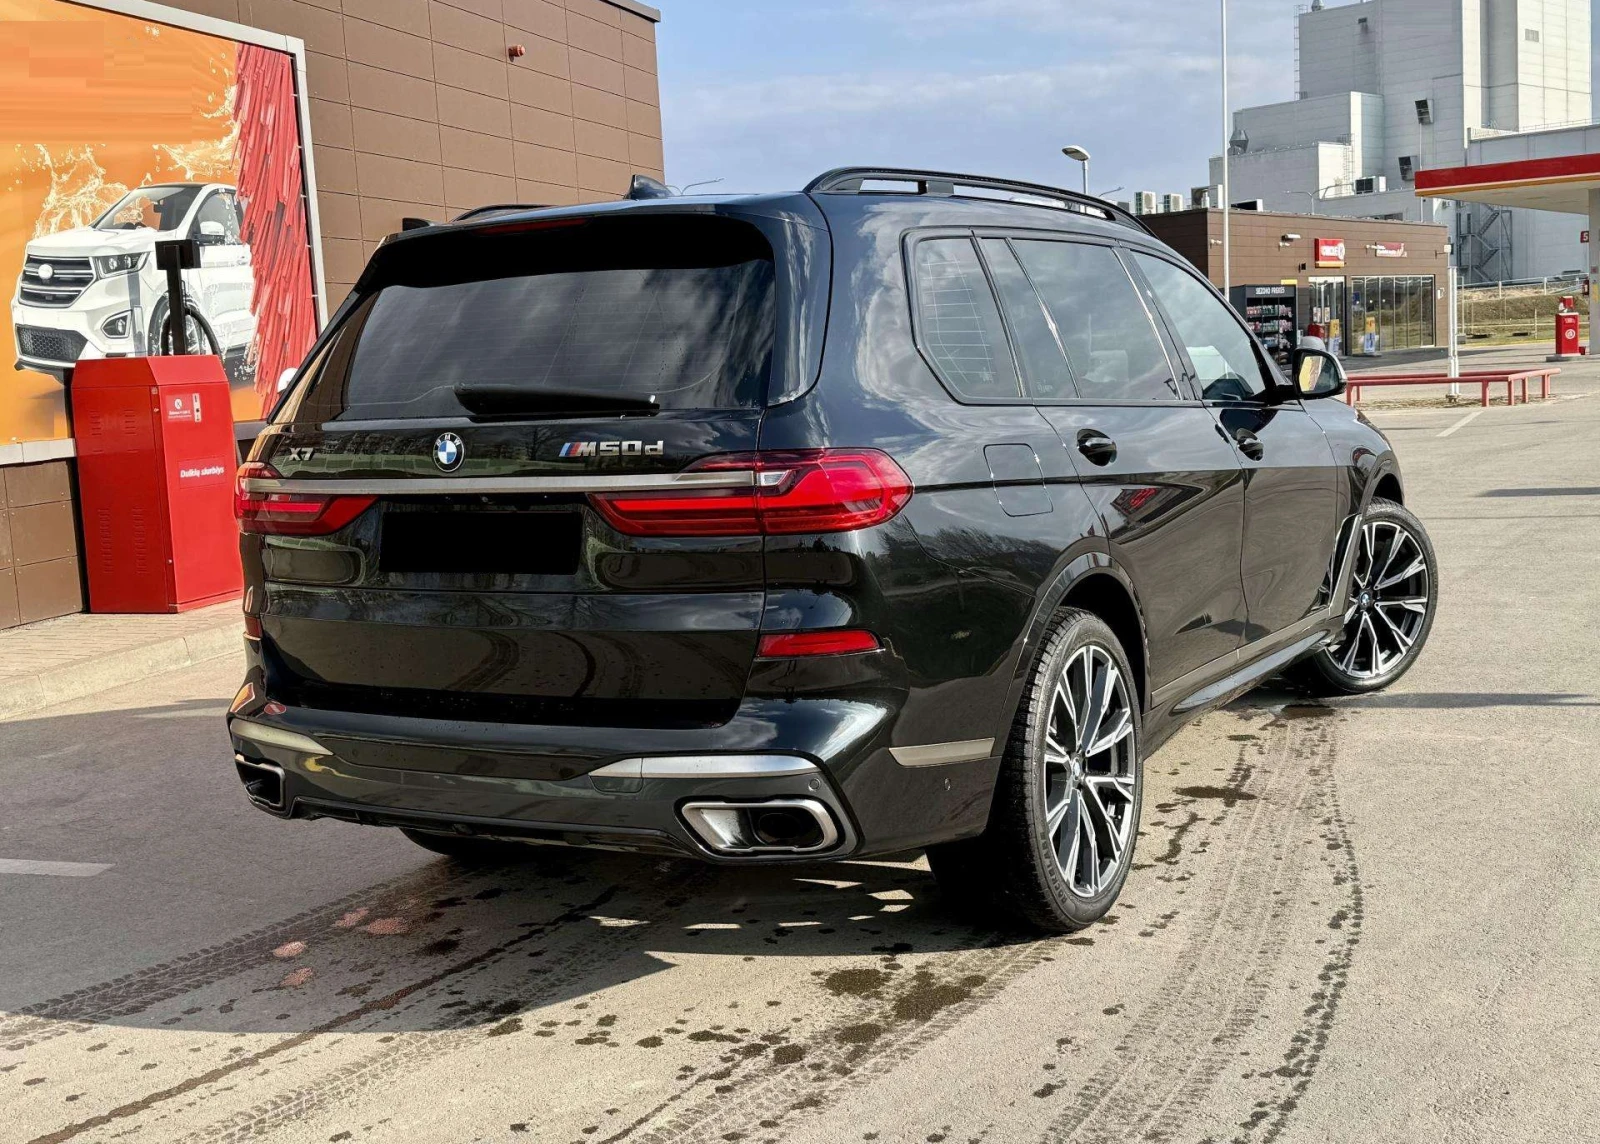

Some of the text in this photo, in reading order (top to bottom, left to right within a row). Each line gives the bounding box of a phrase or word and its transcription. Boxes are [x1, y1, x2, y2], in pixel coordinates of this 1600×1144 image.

[1583, 232, 1588, 241] 5
[288, 447, 314, 461] X7
[575, 440, 664, 457] M50d
